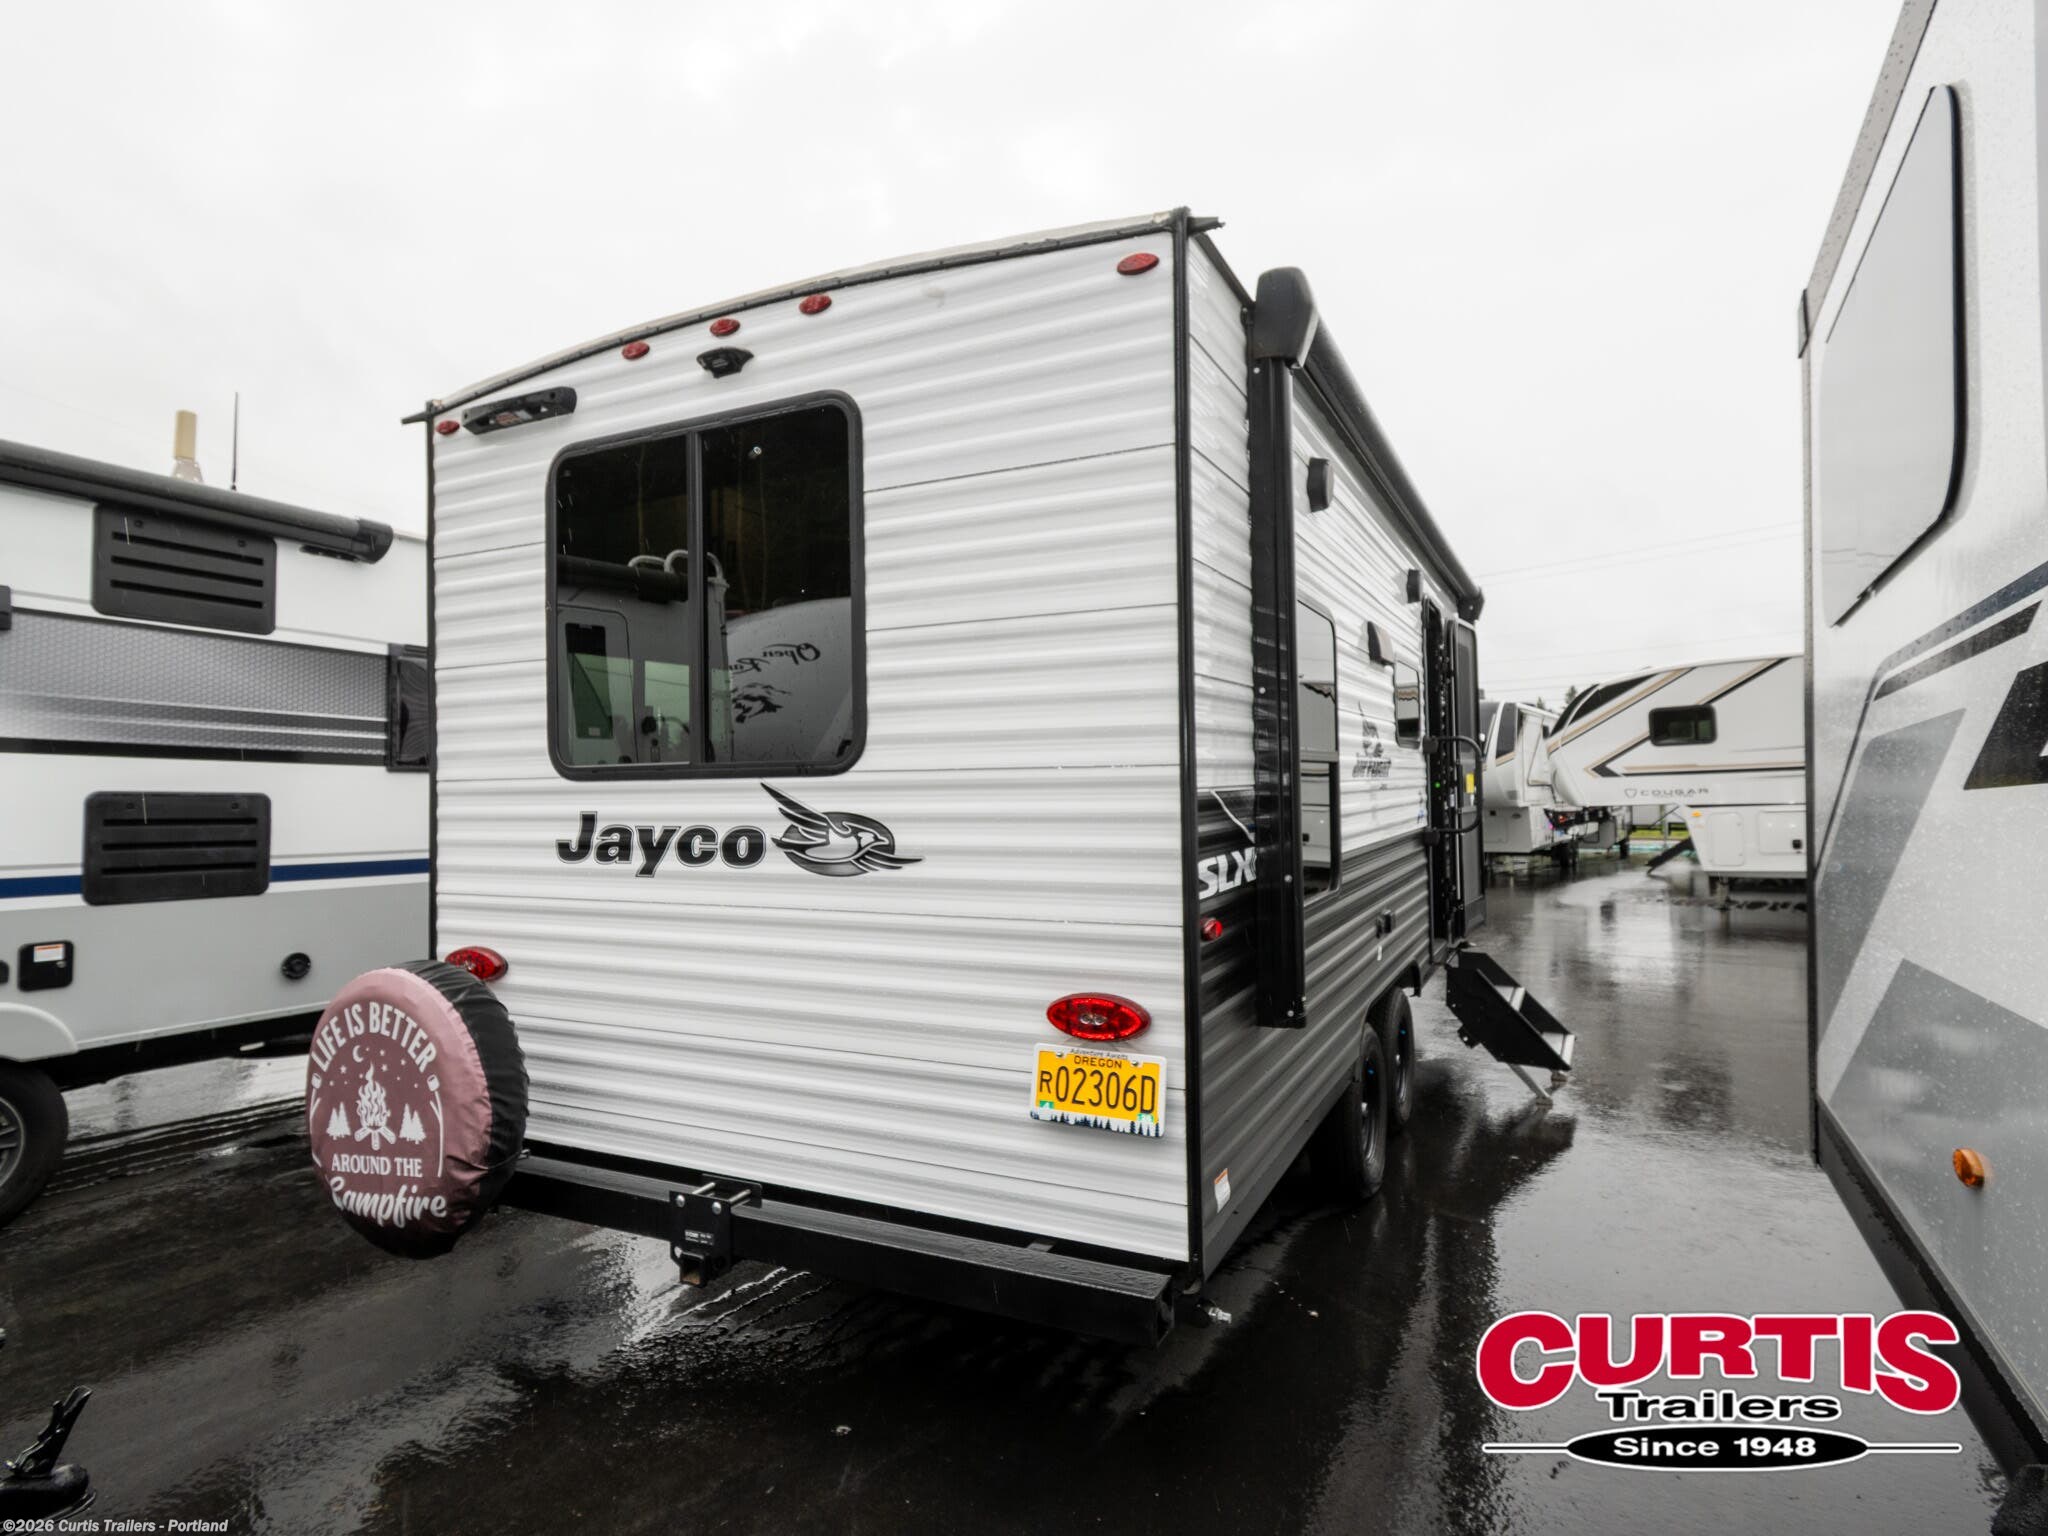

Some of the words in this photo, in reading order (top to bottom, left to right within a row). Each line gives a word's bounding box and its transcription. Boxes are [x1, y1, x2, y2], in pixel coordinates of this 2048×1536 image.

[1641, 787, 1709, 797] COUGAR
[555, 811, 767, 878] Jayco
[1198, 846, 1257, 900] SLX
[311, 1016, 347, 1072] LIFE
[344, 1003, 365, 1038] IS
[368, 1001, 437, 1073] BETTER
[1073, 1055, 1122, 1068] OREGON
[1040, 1066, 1156, 1114] R02306D
[331, 1154, 391, 1175] AROUND
[394, 1157, 423, 1178] THE
[330, 1176, 447, 1228] Campfire
